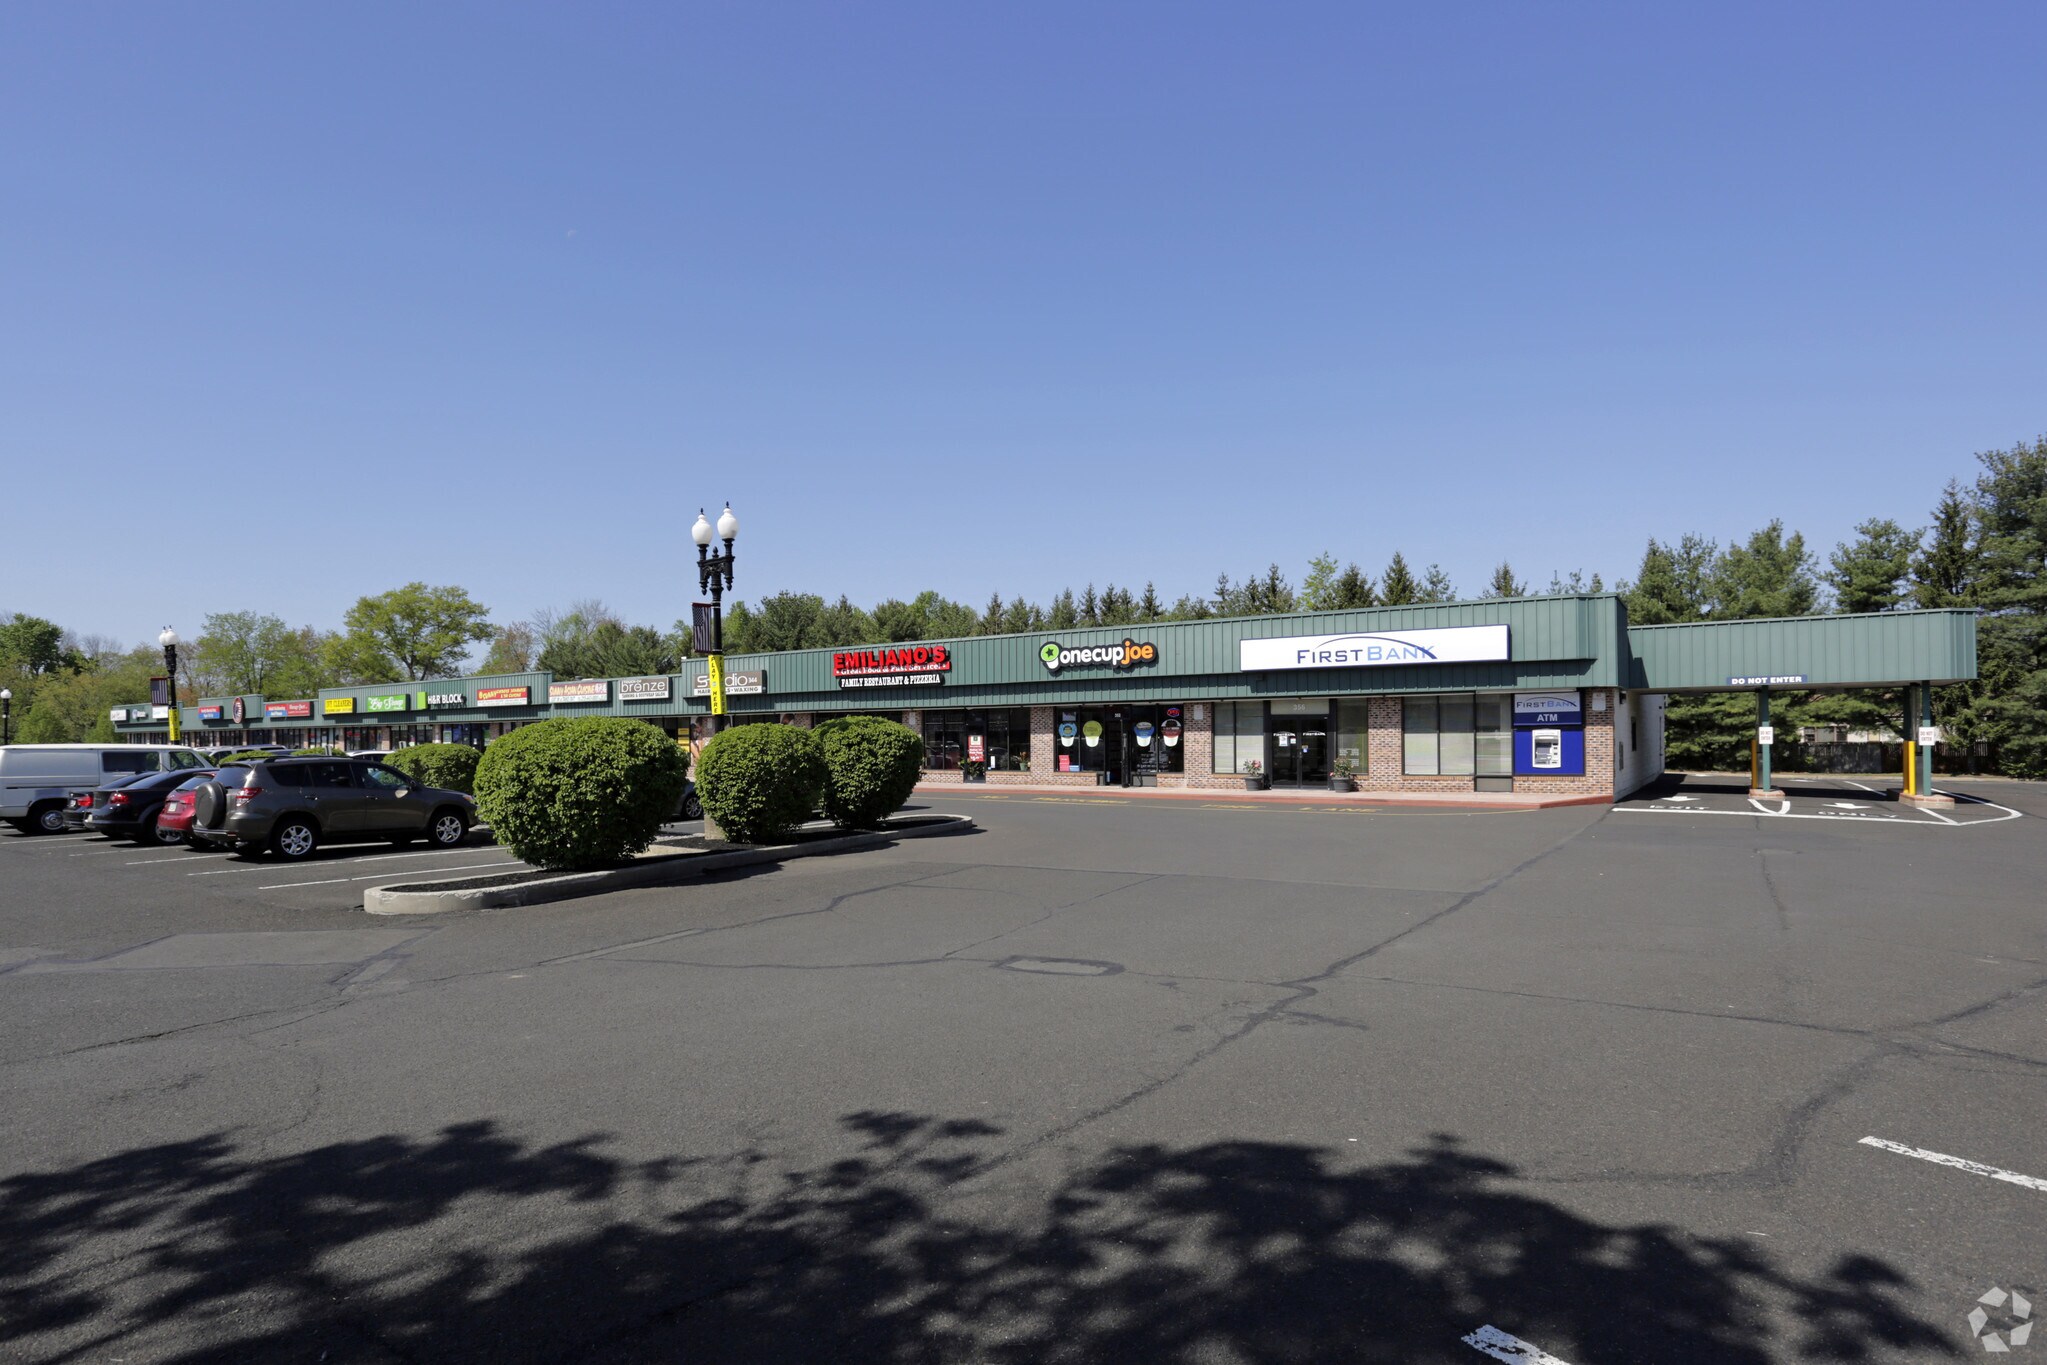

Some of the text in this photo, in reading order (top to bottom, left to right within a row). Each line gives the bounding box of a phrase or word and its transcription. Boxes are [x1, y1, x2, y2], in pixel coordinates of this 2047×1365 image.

[833, 645, 946, 670] EMILIANO'S
[1060, 640, 1154, 665] onecupjoe
[621, 680, 666, 692] bronze
[841, 674, 941, 688] FAMILY RESTAURANT & PIZZERIA
[1770, 676, 1802, 684] ENTER
[428, 693, 462, 705] H&R BLOCK
[1536, 713, 1558, 722] ATM
